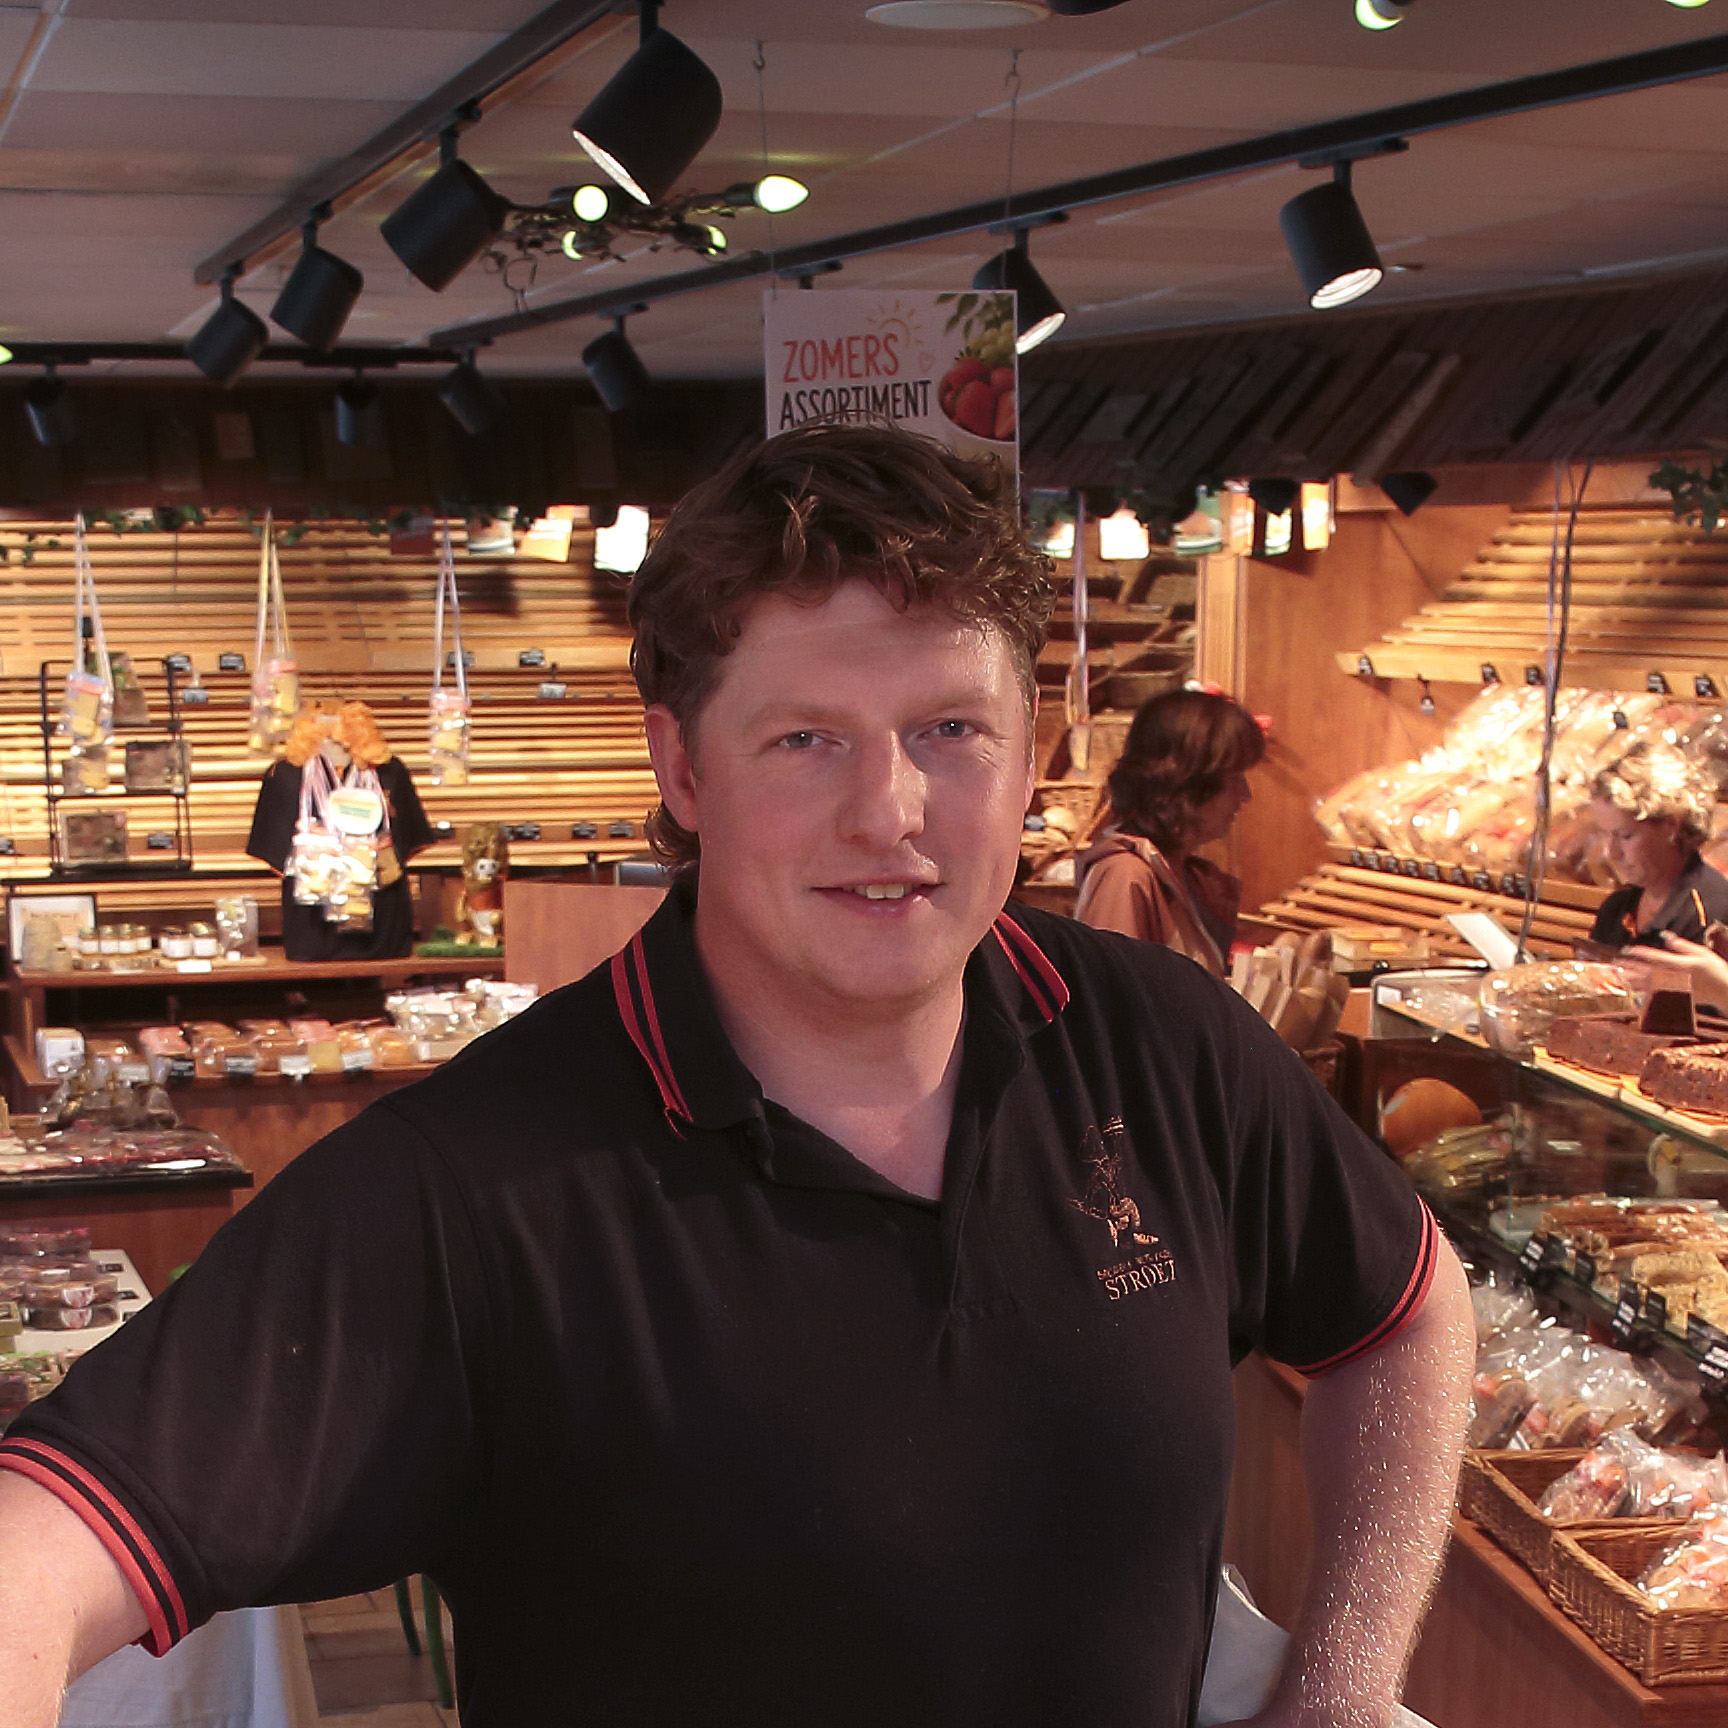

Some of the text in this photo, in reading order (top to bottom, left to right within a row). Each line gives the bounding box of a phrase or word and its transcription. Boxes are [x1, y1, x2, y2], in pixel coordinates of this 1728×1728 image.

[783, 333, 899, 384] ZOMERS
[779, 379, 932, 431] ASSORTIMENT
[1105, 1259, 1176, 1301] STROET
